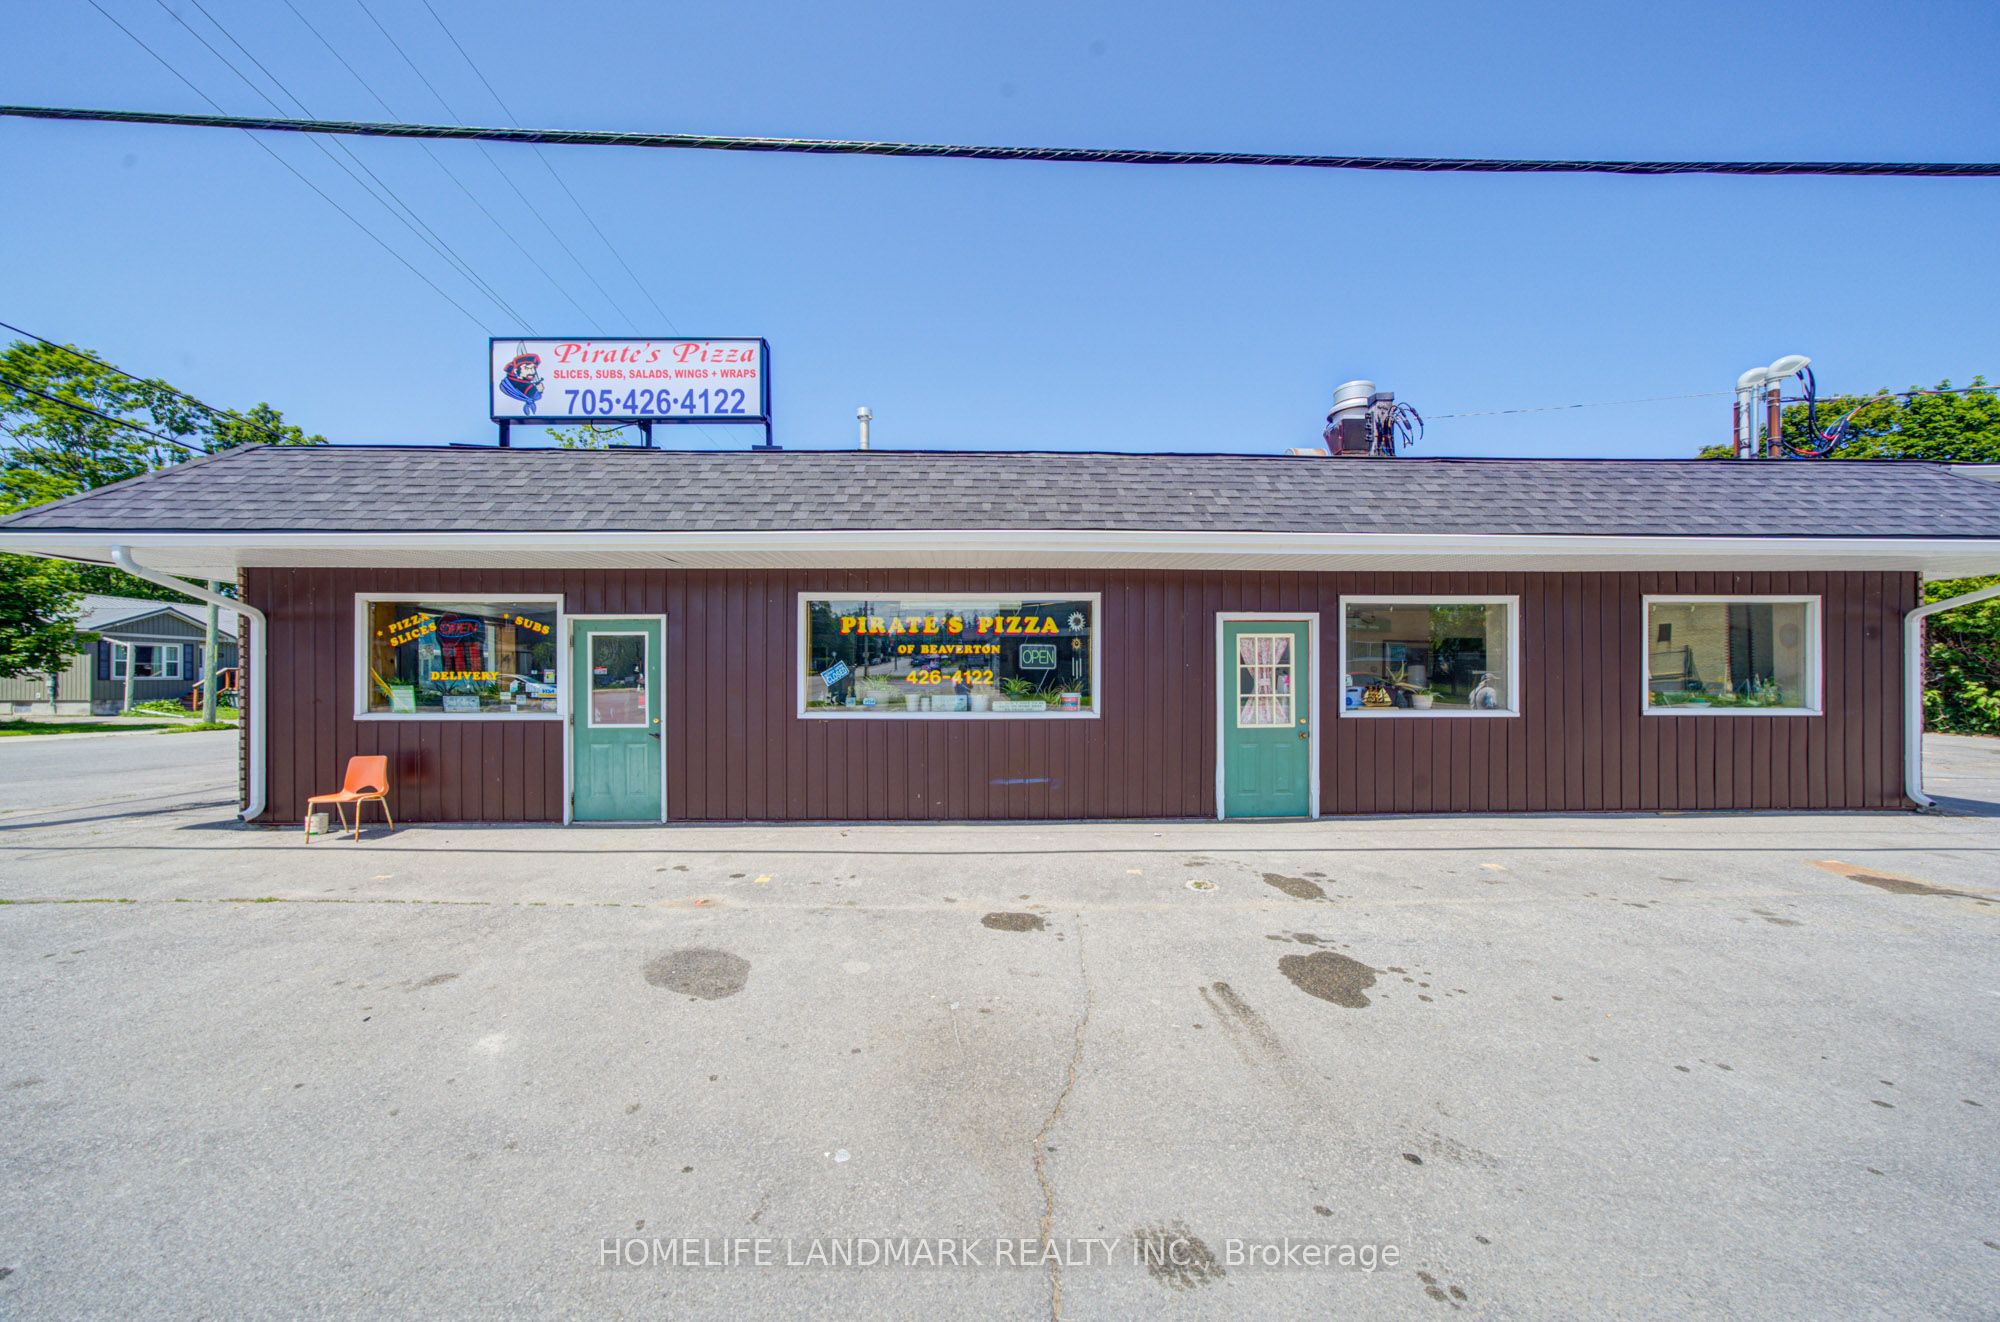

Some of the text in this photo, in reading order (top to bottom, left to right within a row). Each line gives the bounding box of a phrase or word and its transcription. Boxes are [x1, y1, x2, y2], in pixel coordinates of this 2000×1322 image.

[554, 342, 755, 363] Pirate's Pizza
[553, 370, 593, 380] SLICES,
[595, 370, 626, 380] SUBS,
[629, 370, 672, 380] SALADS,
[674, 369, 708, 379] WINGS
[721, 369, 756, 378] WRAPS
[388, 612, 430, 634] PIZZA
[440, 622, 478, 635] OPEN
[515, 616, 550, 635] SUBS
[840, 616, 1059, 635] PIRATE'S PIZZA
[389, 622, 437, 647] SLICES
[897, 644, 1001, 655] OF BEAVERTON
[1022, 650, 1055, 664] OPEN
[430, 671, 499, 681] DELIVERY
[826, 666, 848, 683] CLOSED
[906, 669, 994, 686] 426-4122
